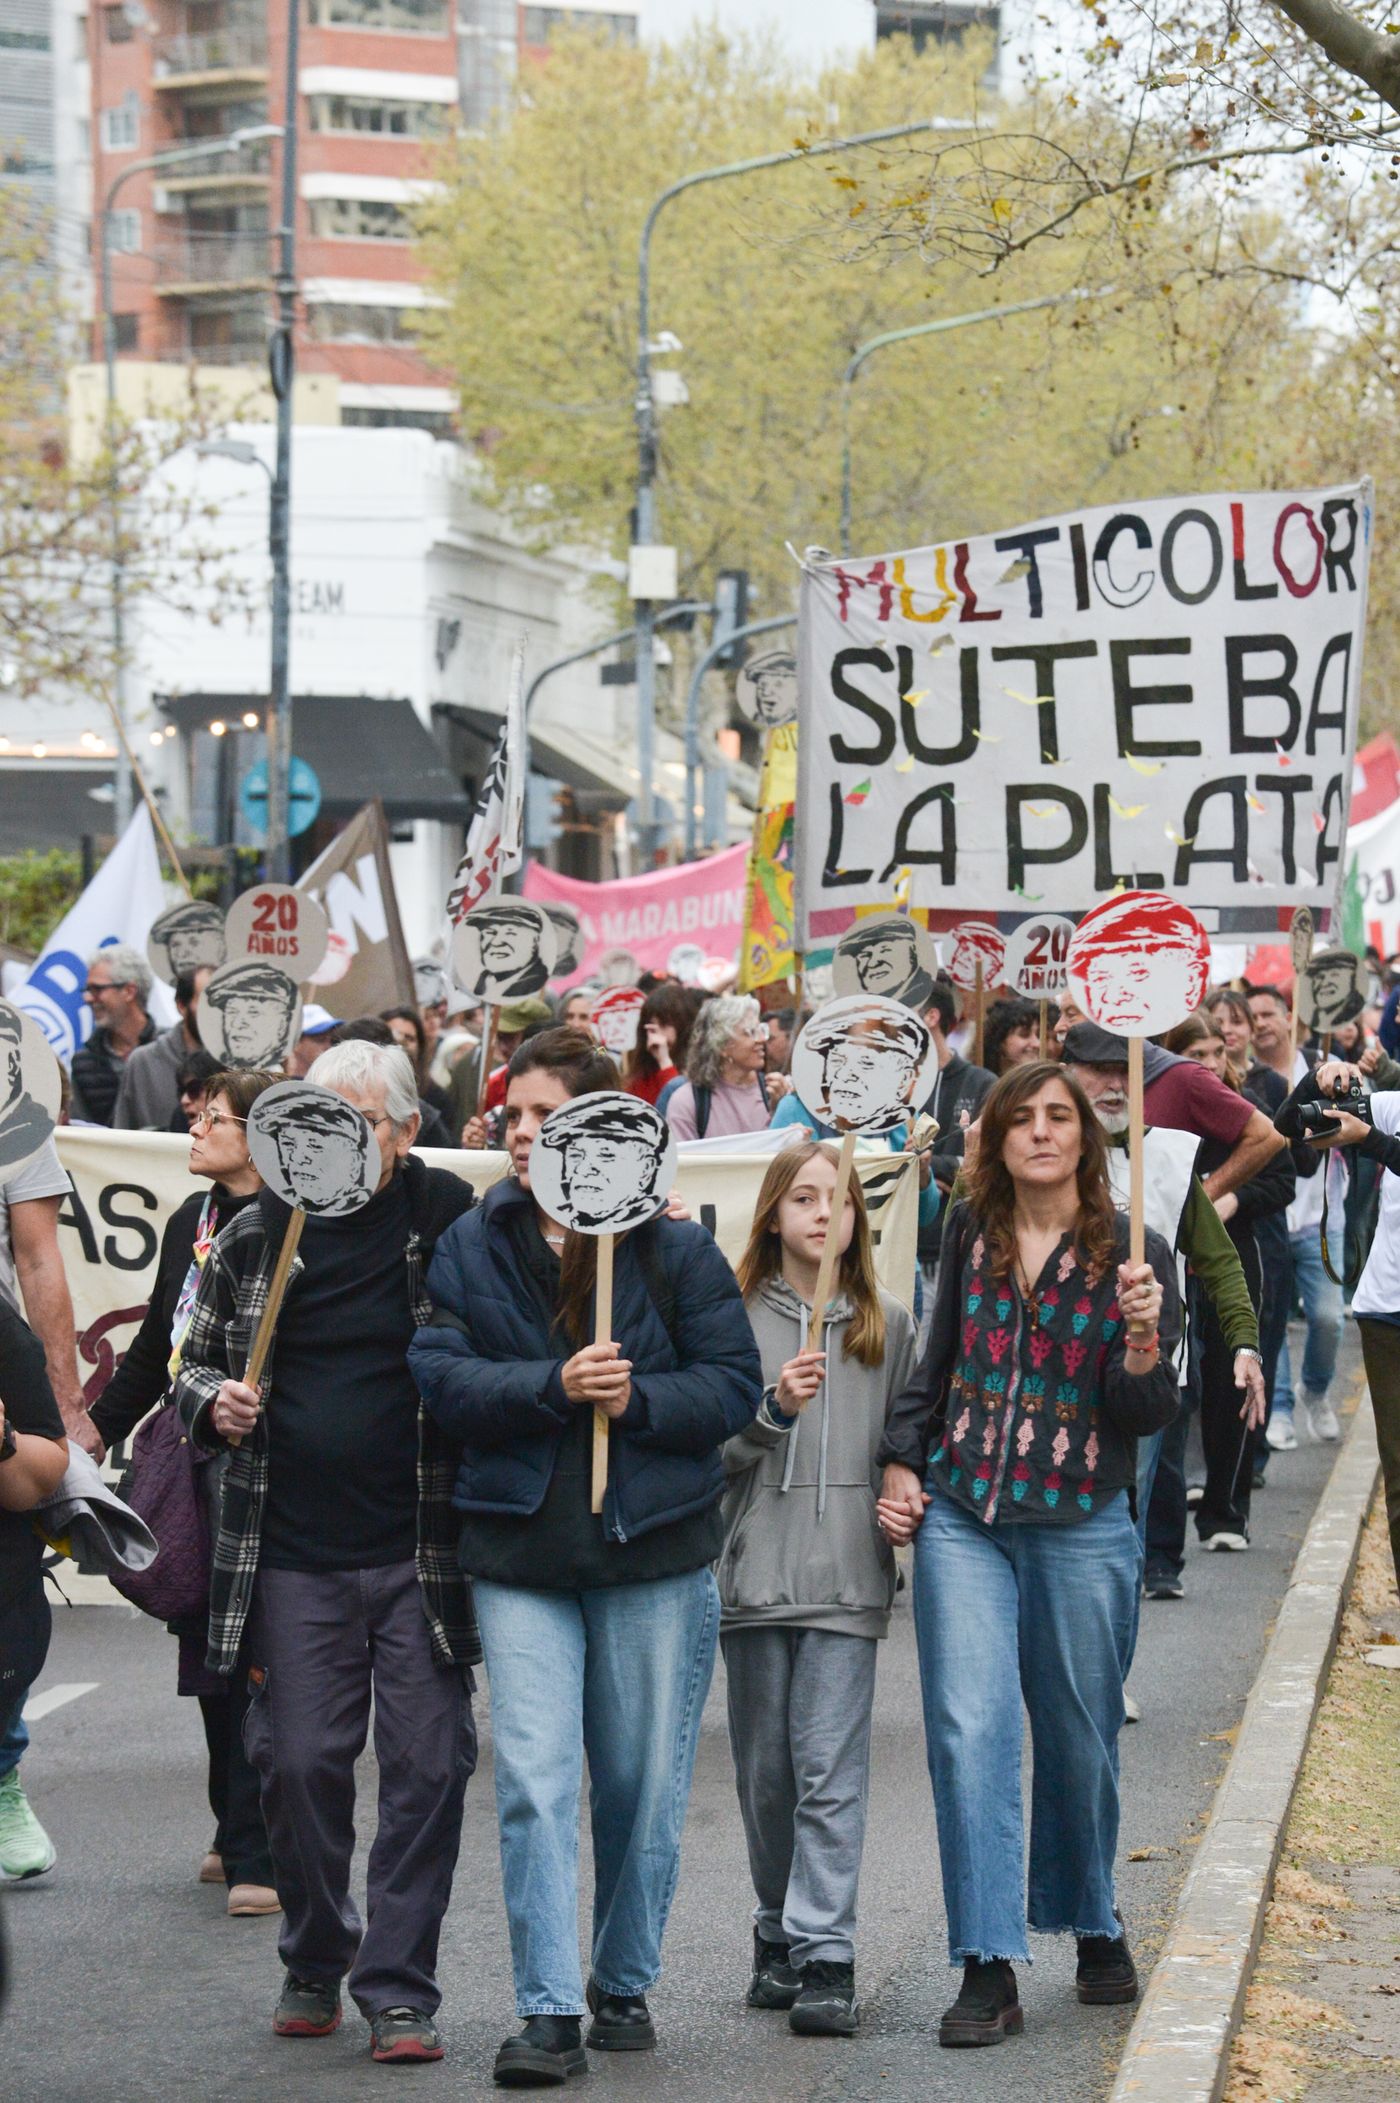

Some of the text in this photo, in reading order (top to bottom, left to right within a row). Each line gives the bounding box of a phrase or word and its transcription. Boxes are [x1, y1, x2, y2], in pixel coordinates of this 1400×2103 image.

[831, 498, 1358, 622] MULTICOLOR
[829, 631, 1353, 766] SUTEBA
[822, 773, 1343, 891] LA PLATA
[251, 893, 298, 932] 20
[246, 932, 299, 956] AÑOS
[1024, 923, 1072, 966] 20
[1016, 965, 1068, 990] AÑOS
